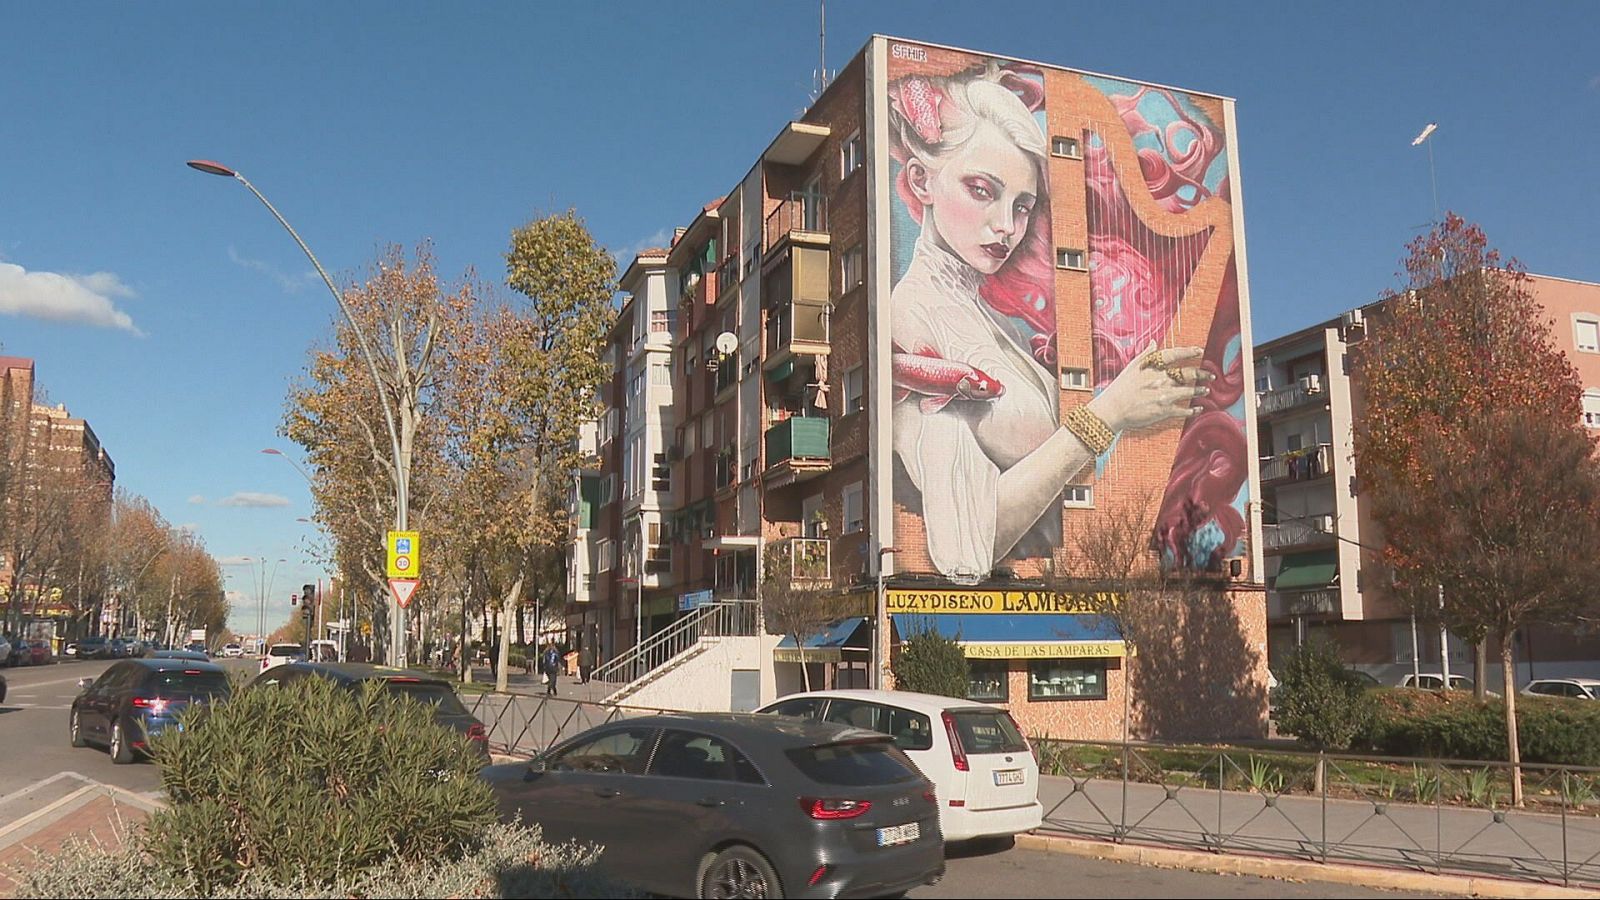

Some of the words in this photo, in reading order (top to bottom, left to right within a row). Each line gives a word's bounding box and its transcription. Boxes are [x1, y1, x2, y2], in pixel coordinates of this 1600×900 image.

[969, 645, 1000, 657] CASA
[1004, 646, 1020, 657] DE
[1023, 645, 1046, 657] LAS
[1049, 644, 1110, 656] LAMPARAS
